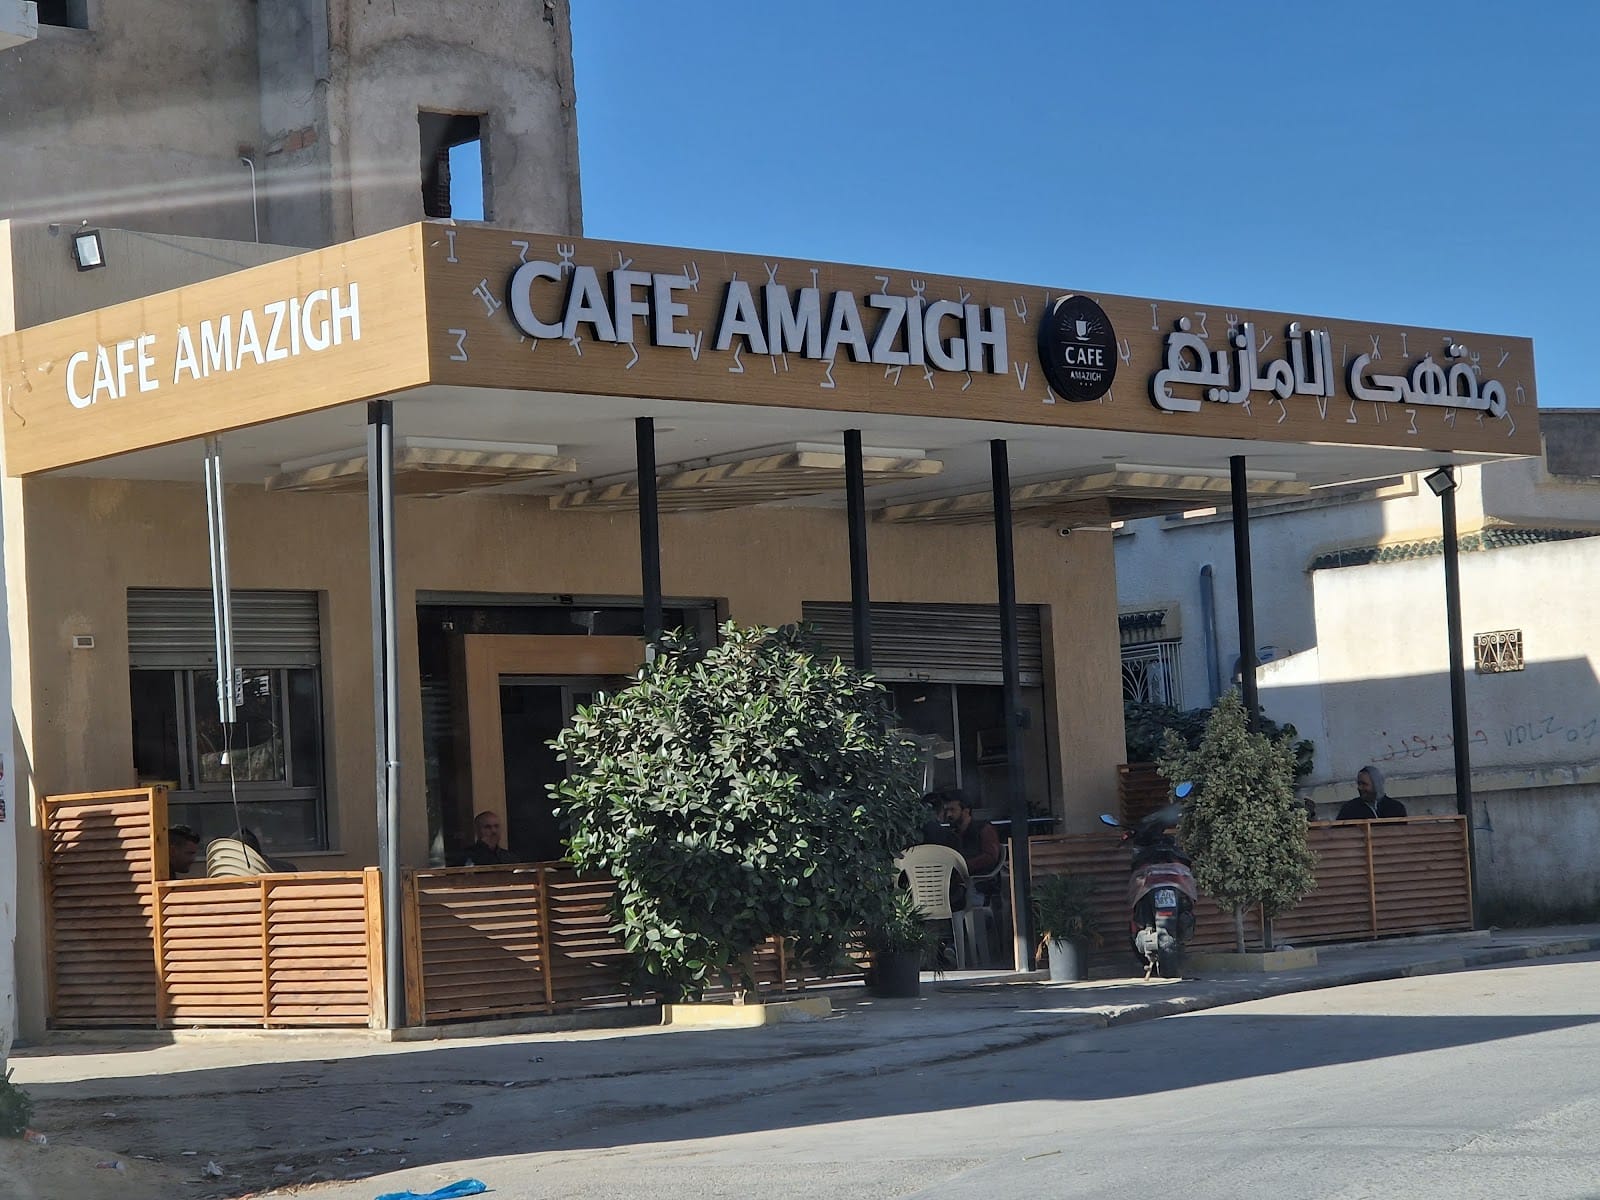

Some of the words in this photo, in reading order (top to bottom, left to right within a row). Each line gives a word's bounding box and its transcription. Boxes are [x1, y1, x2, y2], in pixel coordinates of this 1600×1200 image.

[65, 333, 160, 409] CAFE
[172, 282, 361, 385] AMAZIGH
[507, 259, 696, 348] CAFE
[714, 280, 1009, 375] AMAZIGH
[1065, 346, 1104, 367] CAFE
[1070, 370, 1102, 382] AMAZIGH
[1151, 315, 1336, 413] الأمازيغ
[1348, 343, 1508, 419] مقهى
